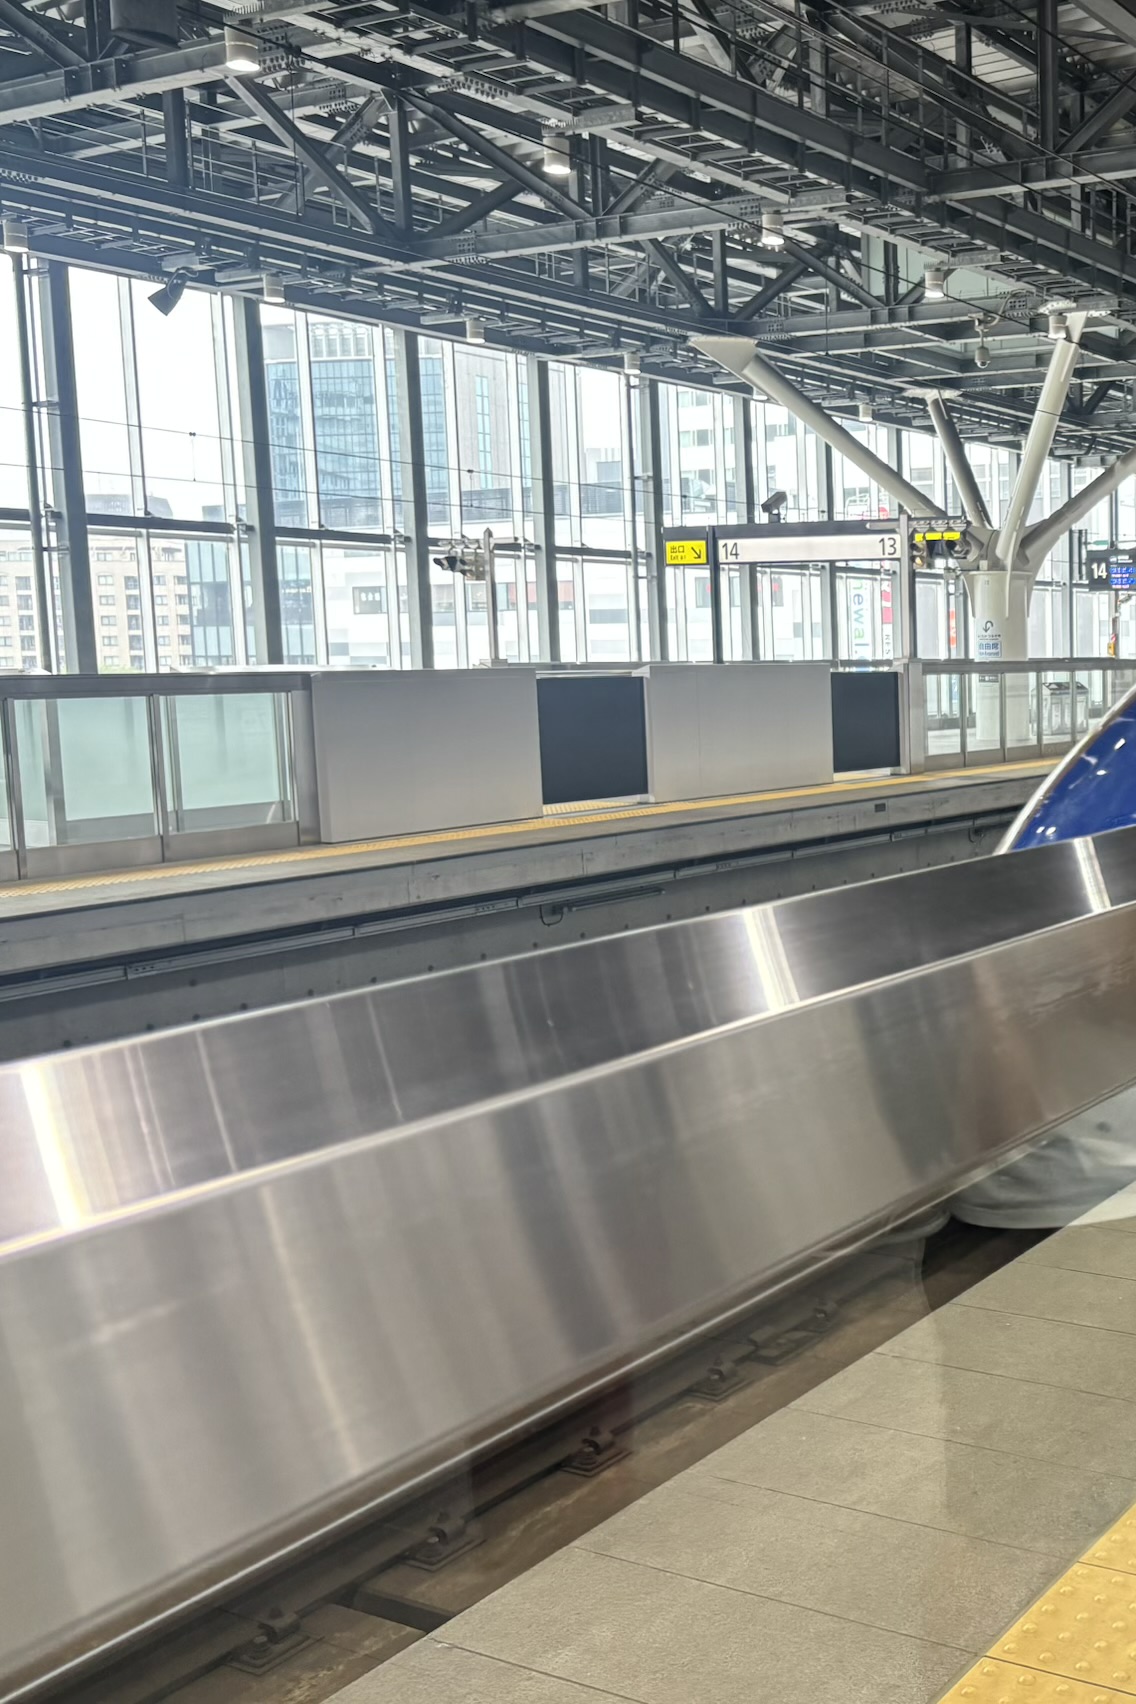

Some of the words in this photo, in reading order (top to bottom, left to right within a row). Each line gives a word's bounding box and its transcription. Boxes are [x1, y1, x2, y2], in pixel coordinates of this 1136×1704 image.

[670, 545, 685, 554] 出口
[722, 542, 740, 560] 14
[878, 537, 897, 556] 13
[1091, 562, 1108, 579] 14
